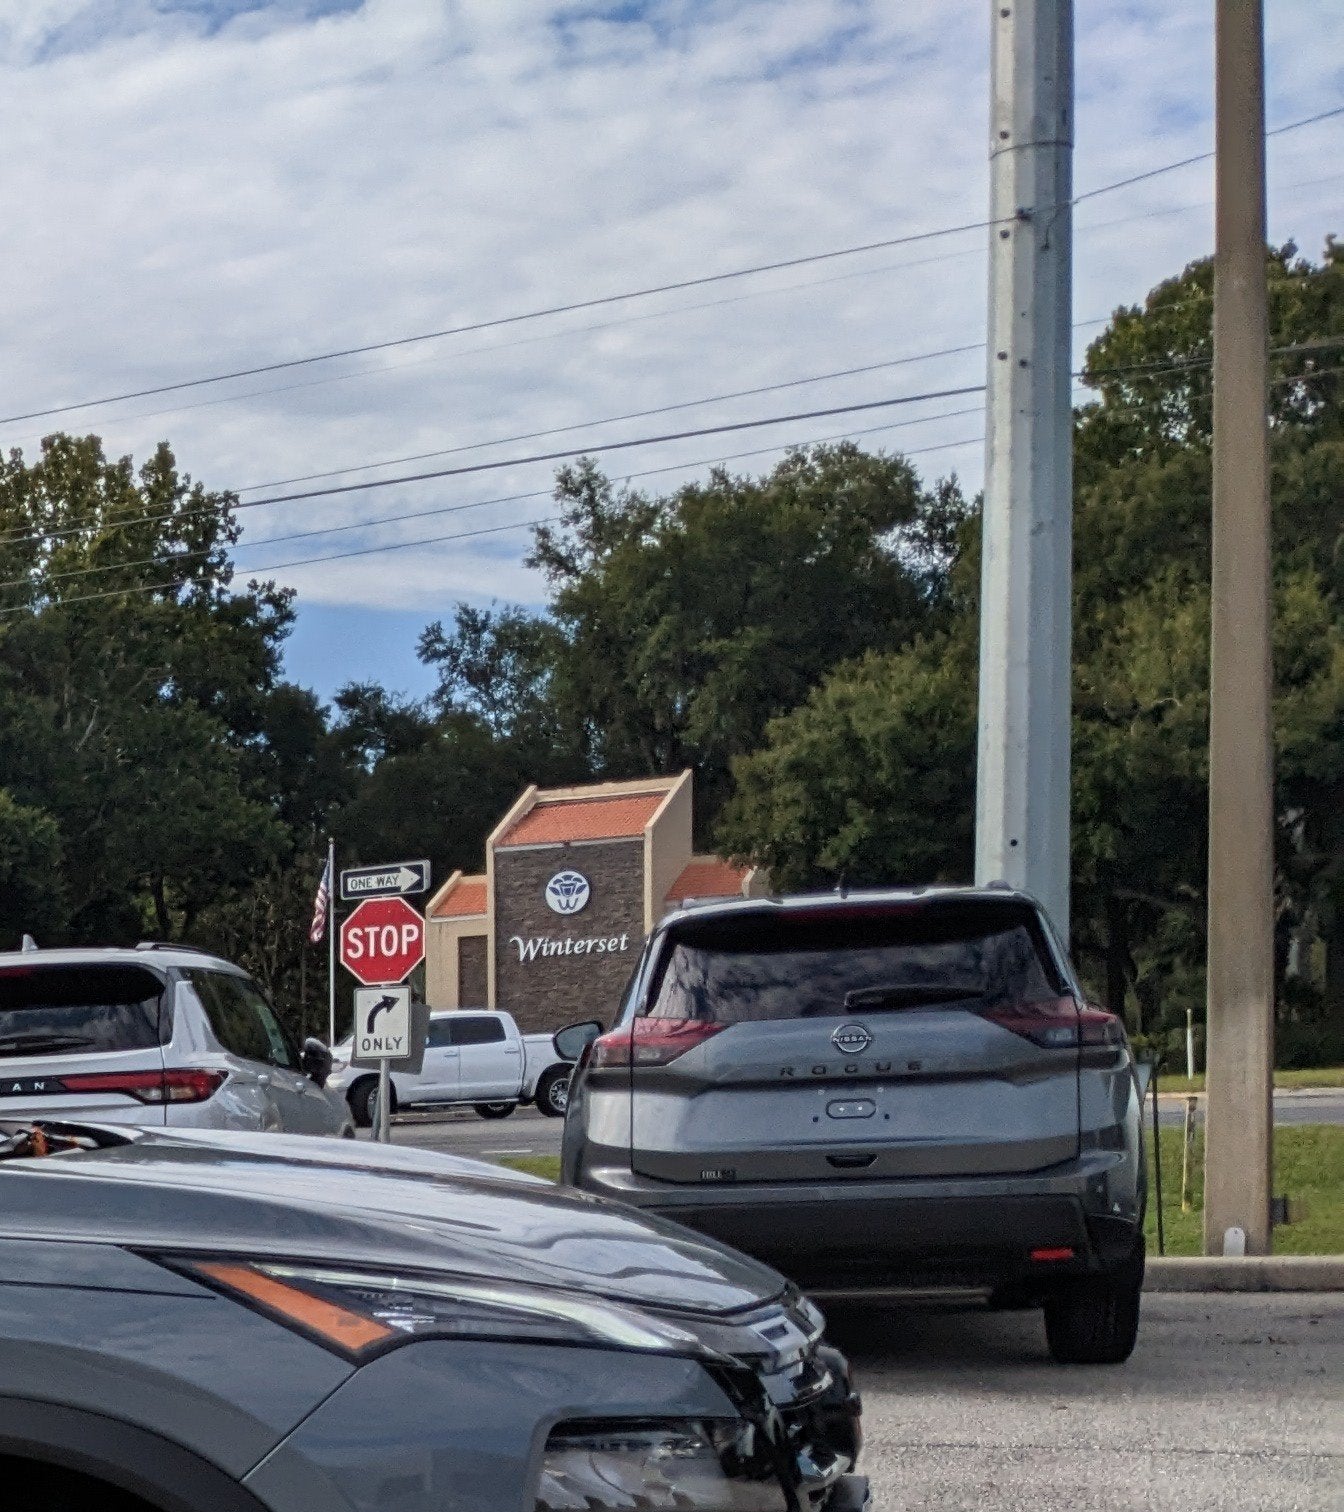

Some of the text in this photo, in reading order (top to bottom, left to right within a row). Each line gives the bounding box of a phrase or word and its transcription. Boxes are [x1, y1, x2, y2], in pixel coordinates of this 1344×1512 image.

[350, 873, 400, 891] ONE WAY
[346, 923, 419, 960] STOP
[509, 933, 630, 962] Winterset
[362, 1036, 403, 1051] ONLY
[780, 1060, 922, 1077] ROGUE
